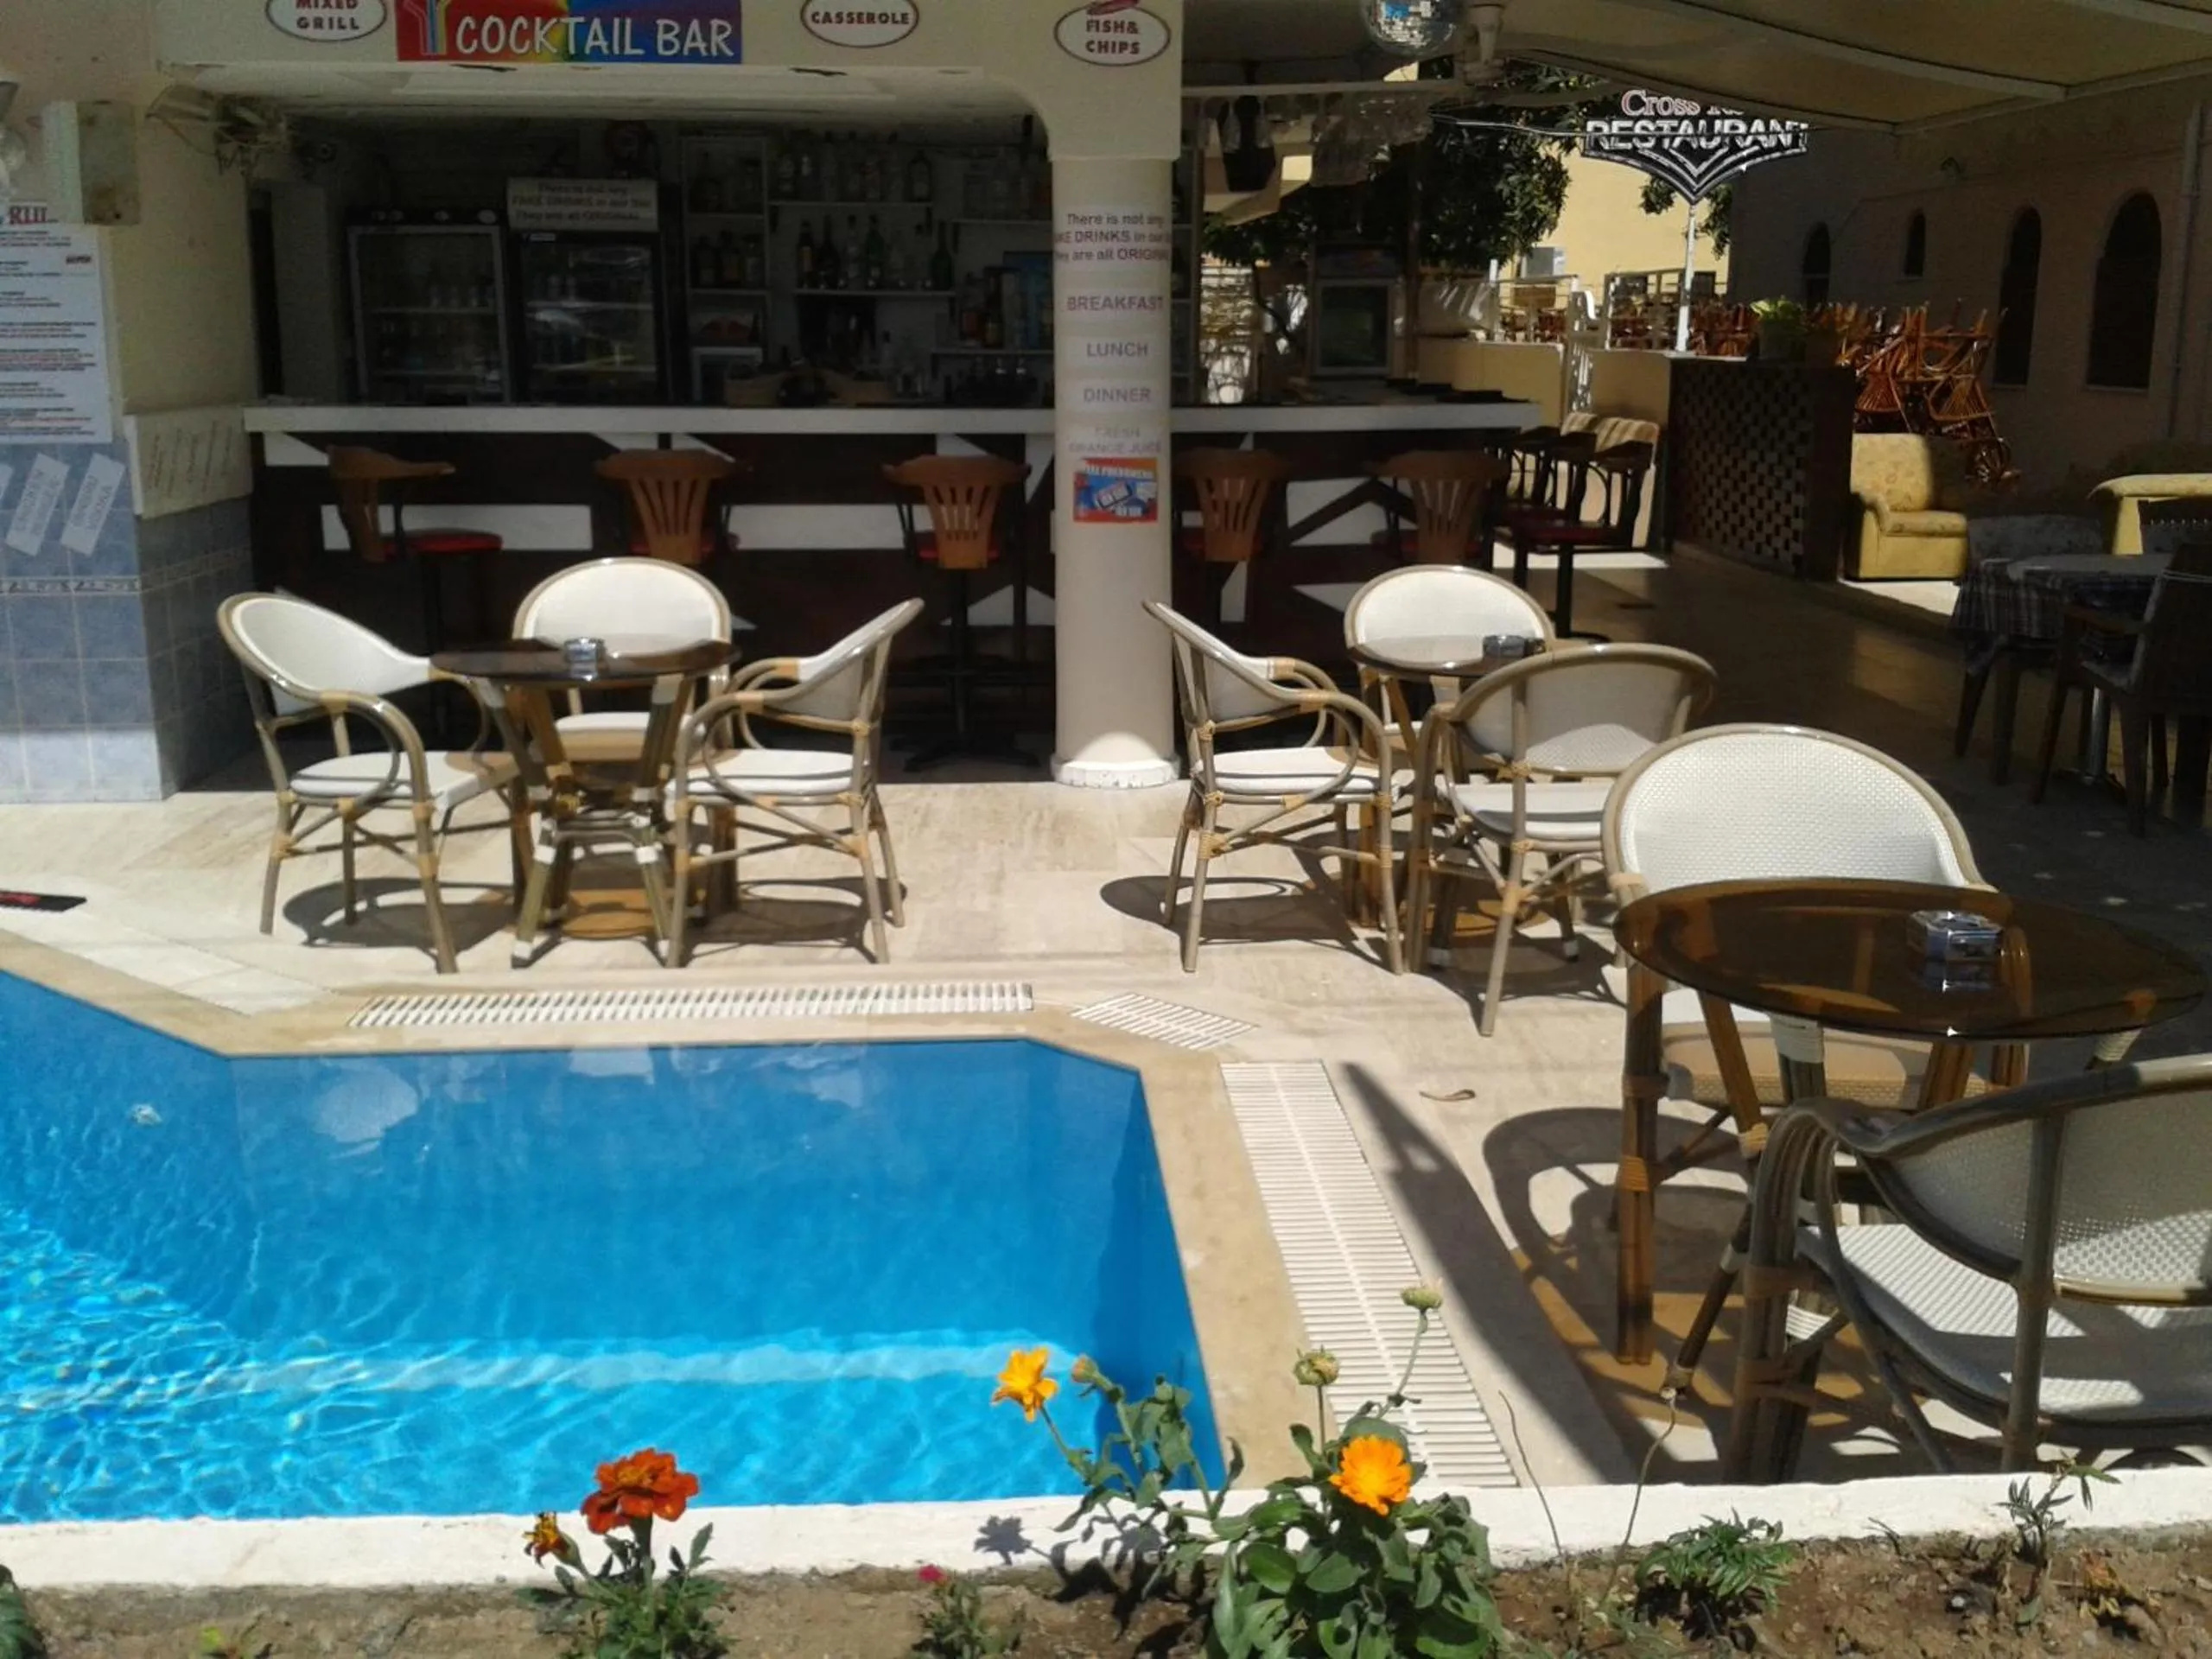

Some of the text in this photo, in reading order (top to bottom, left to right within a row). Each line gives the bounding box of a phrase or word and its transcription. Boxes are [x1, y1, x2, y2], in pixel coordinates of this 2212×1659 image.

[296, 16, 359, 30] GRILL
[810, 10, 910, 25] CASSEROLE
[1085, 19, 1139, 35] FISH&
[455, 16, 734, 58] COCKTAIL BAR
[1085, 40, 1141, 55] CHIPS
[1621, 89, 1701, 117] Cross
[1067, 213, 1103, 225] There
[1106, 213, 1118, 225] is
[1122, 213, 1143, 225] not
[1075, 230, 1130, 242] DRINKS
[1097, 248, 1115, 260] all
[1066, 296, 1163, 311] BREAKFAST
[1086, 342, 1148, 357] LUNCH
[1083, 387, 1151, 403] DINNER
